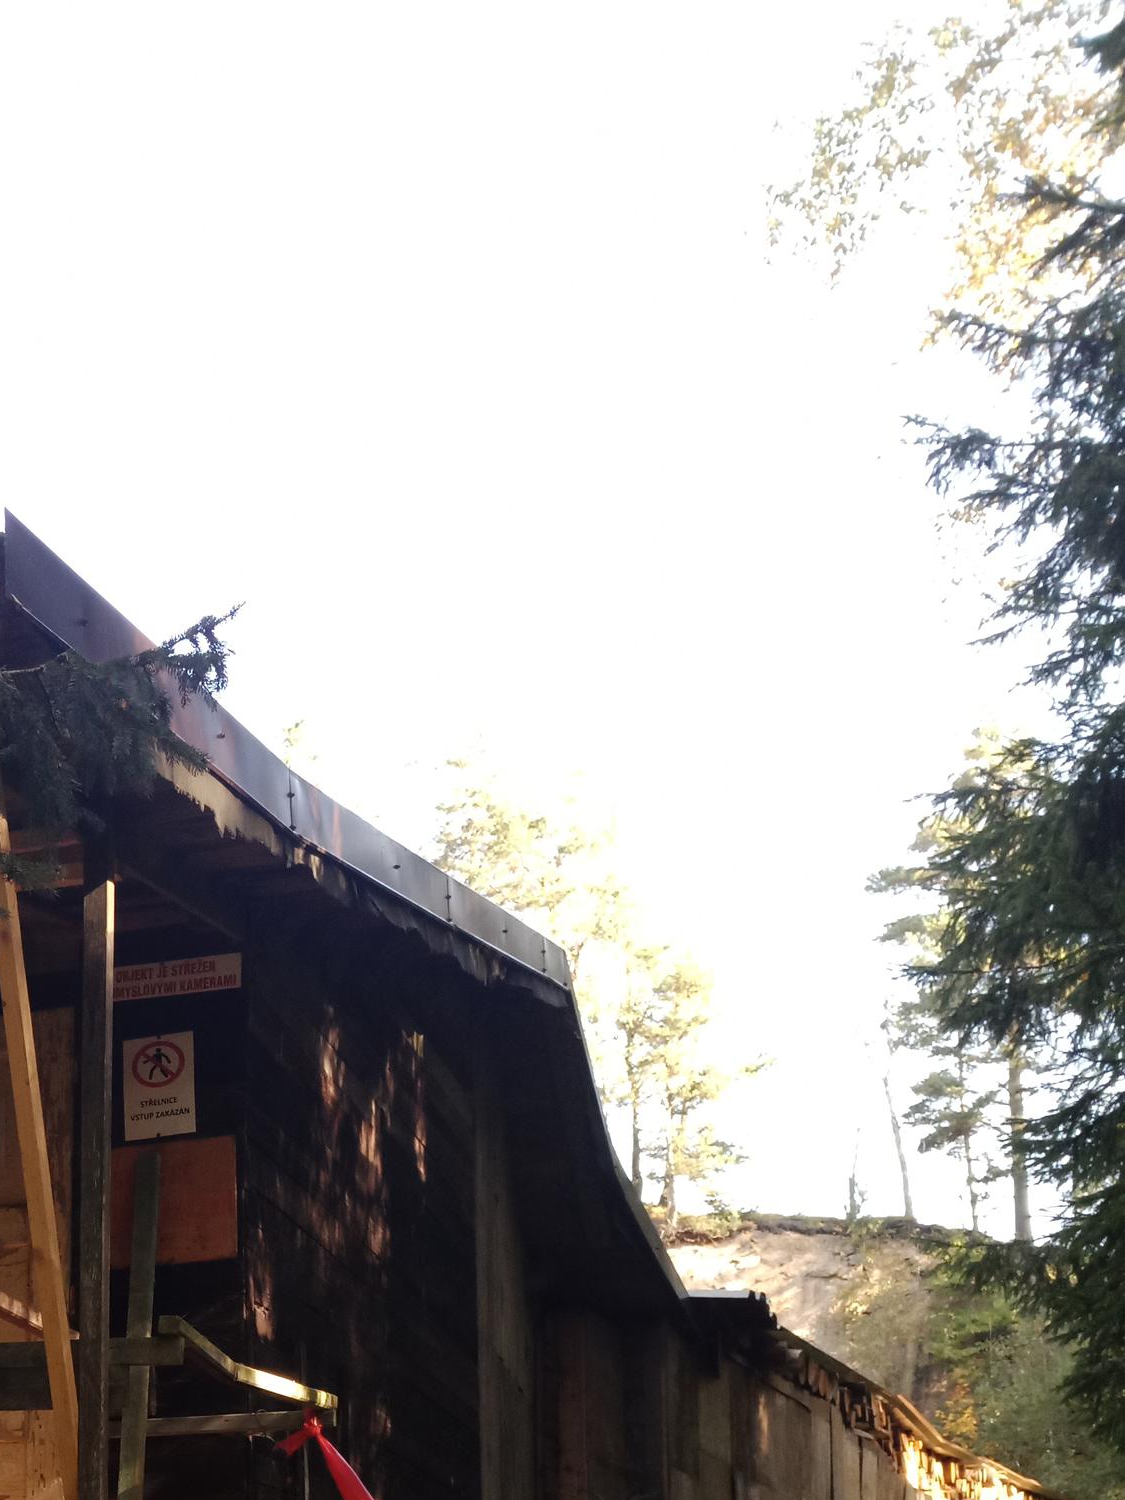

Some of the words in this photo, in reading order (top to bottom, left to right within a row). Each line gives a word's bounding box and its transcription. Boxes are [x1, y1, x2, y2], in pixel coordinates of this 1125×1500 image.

[116, 968, 155, 983] OBJEKT
[157, 966, 168, 979] JE
[180, 974, 237, 992] KAMERAMI
[130, 1112, 154, 1121] VSTUP
